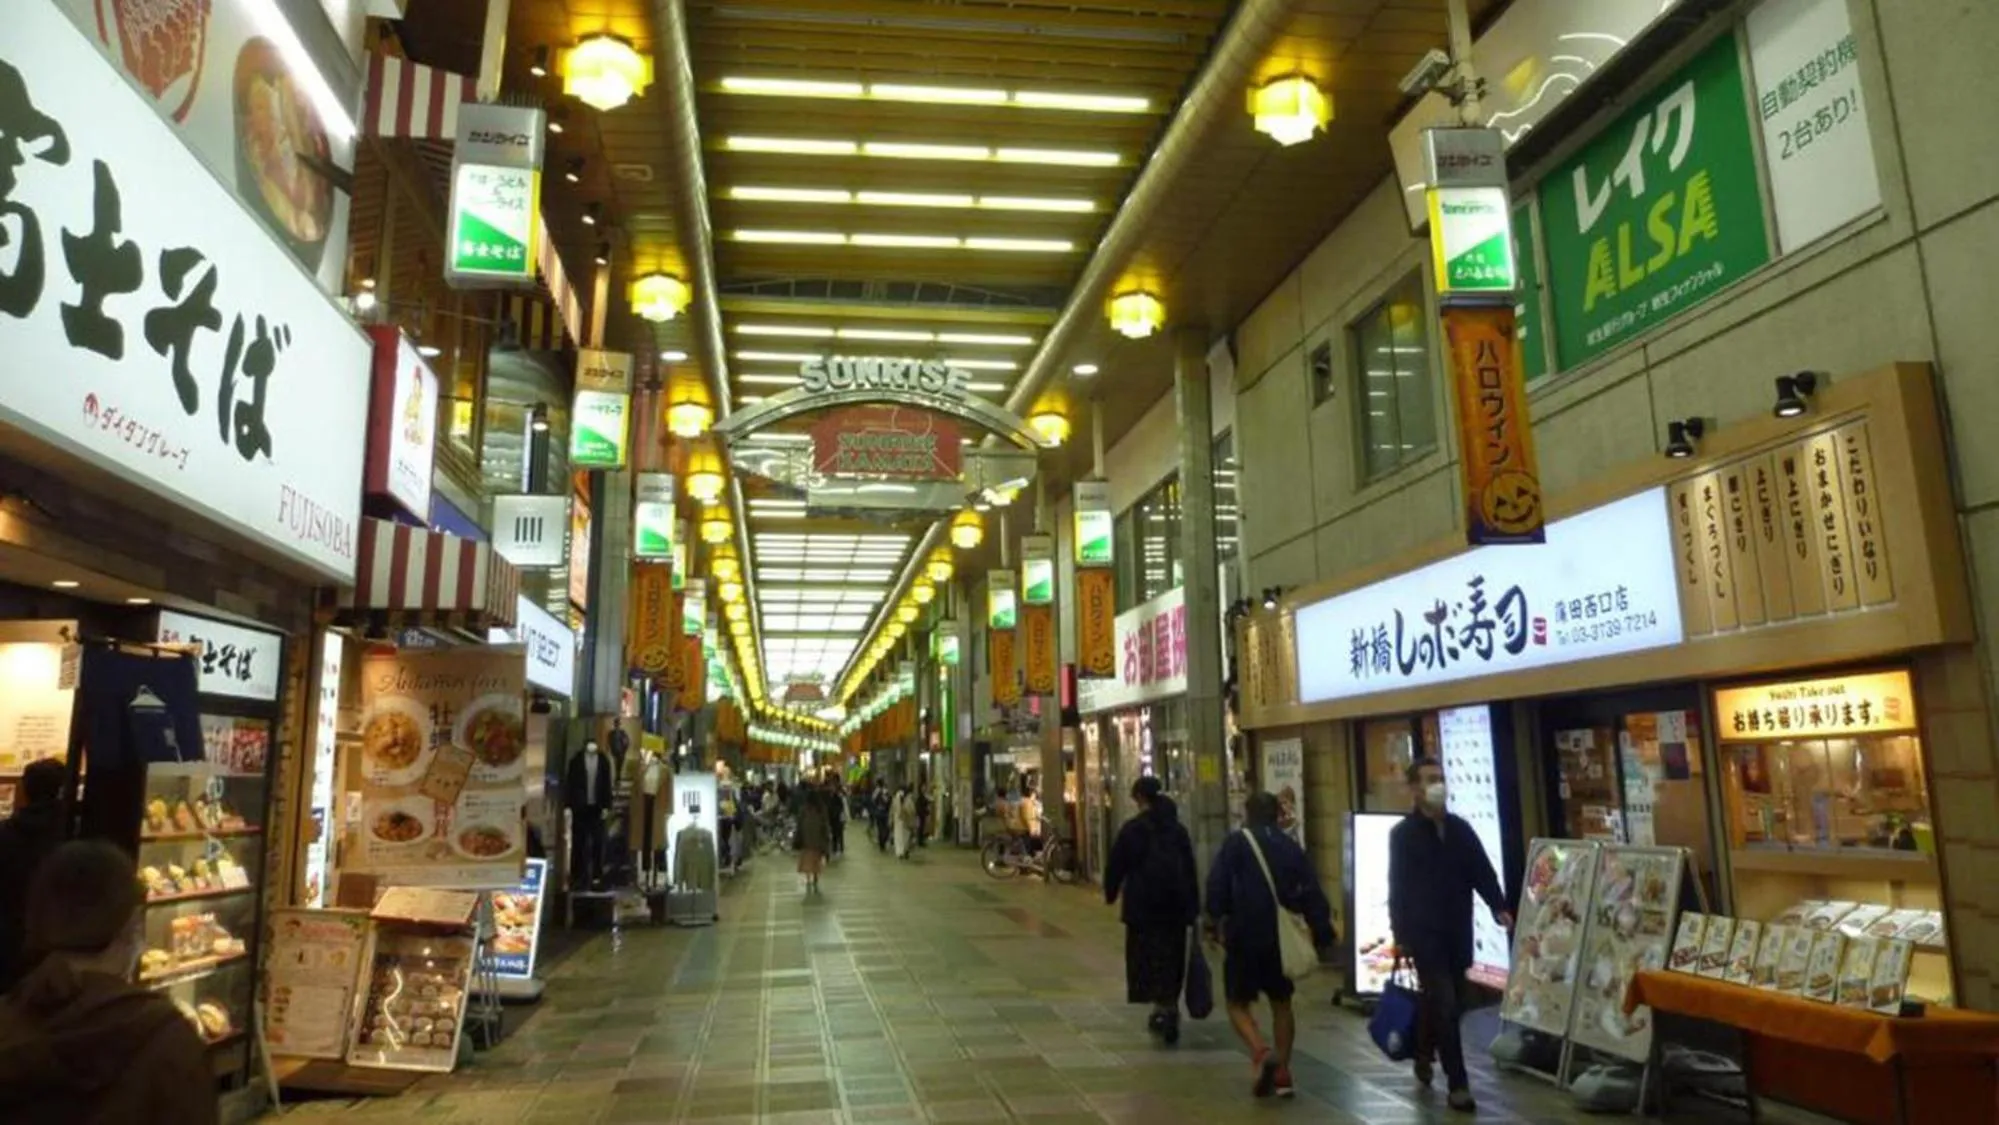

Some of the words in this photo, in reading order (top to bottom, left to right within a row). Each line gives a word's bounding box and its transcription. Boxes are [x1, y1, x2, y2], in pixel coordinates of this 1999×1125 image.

[1762, 34, 1857, 121] 自動契約機
[1572, 79, 1696, 235] レイク
[1584, 169, 1718, 312] ALSA
[801, 354, 973, 401] SUNRISE
[278, 483, 352, 559] FUJISOBA
[1814, 447, 1845, 597] おまかせにぎり
[188, 634, 258, 682] 士そば
